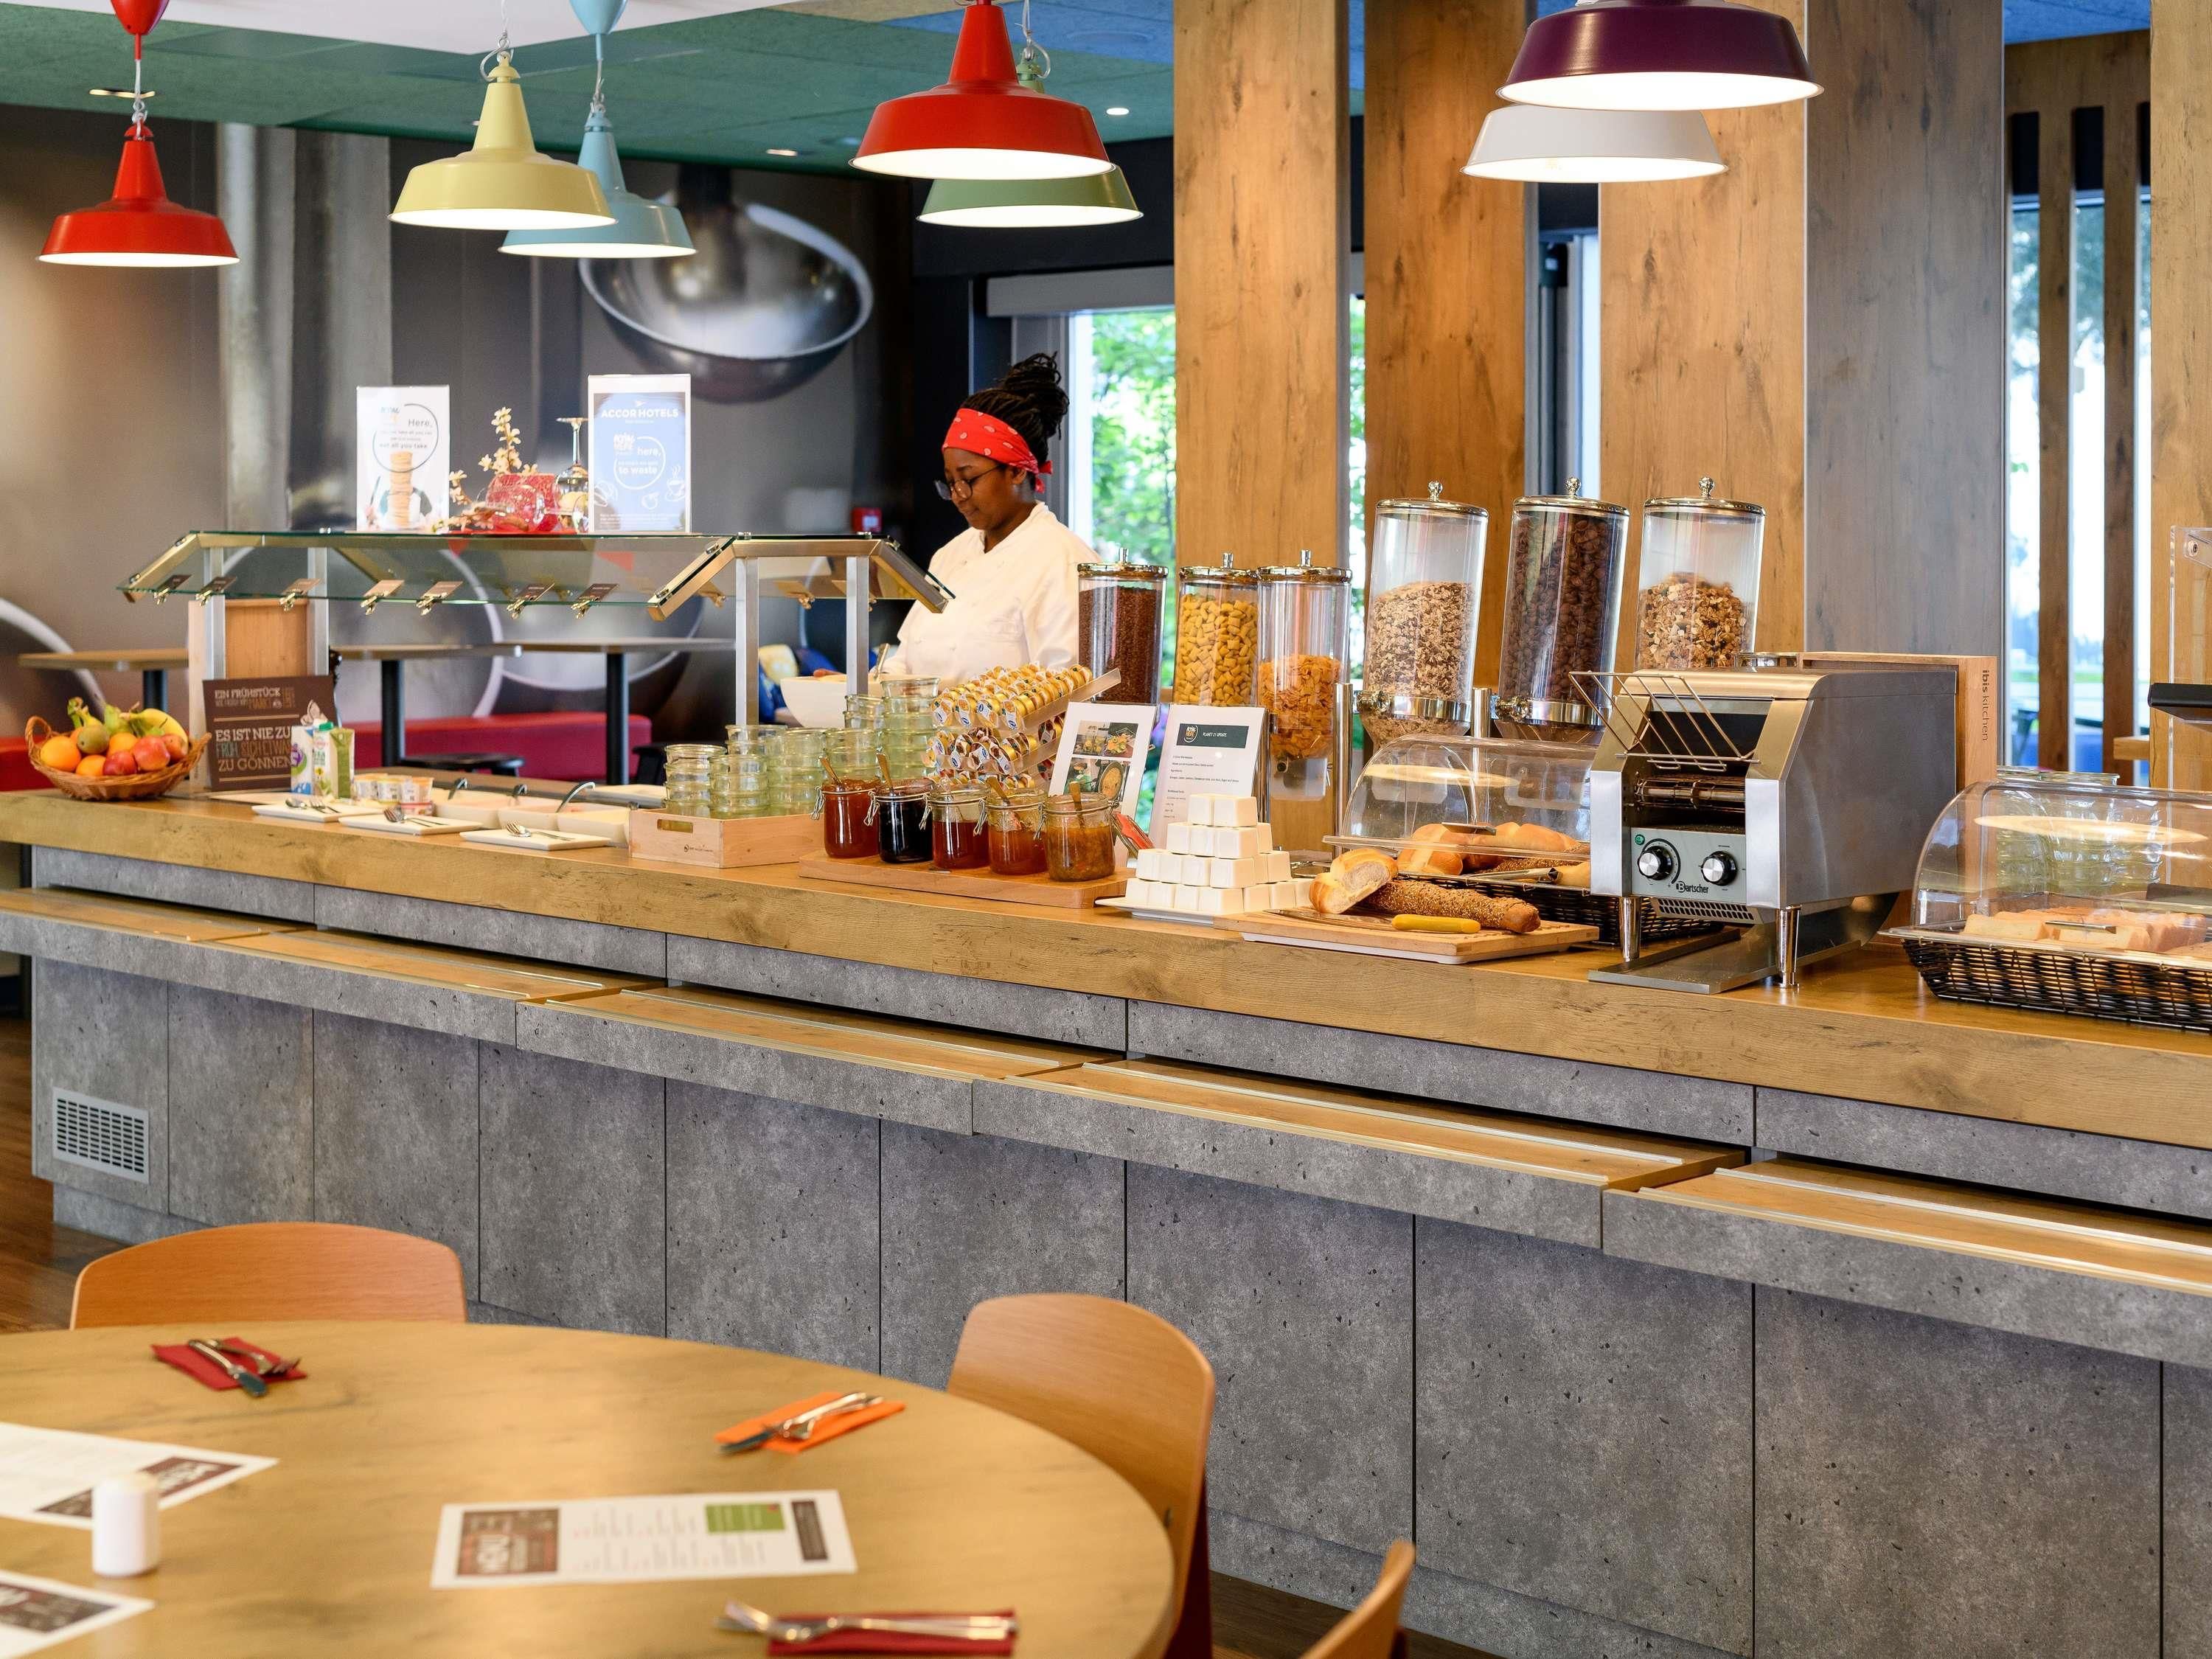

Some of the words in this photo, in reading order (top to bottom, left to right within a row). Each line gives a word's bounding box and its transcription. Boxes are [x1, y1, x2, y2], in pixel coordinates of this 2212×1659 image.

[408, 418, 433, 428] Here,
[637, 446, 661, 457] here,
[619, 465, 628, 474] to
[630, 465, 658, 474] waste
[215, 729, 231, 742] ES
[233, 728, 251, 741] IST
[252, 727, 274, 740] NIE
[275, 726, 291, 739] ZU
[218, 759, 234, 772] ZU
[1676, 881, 1709, 894] Bartscher
